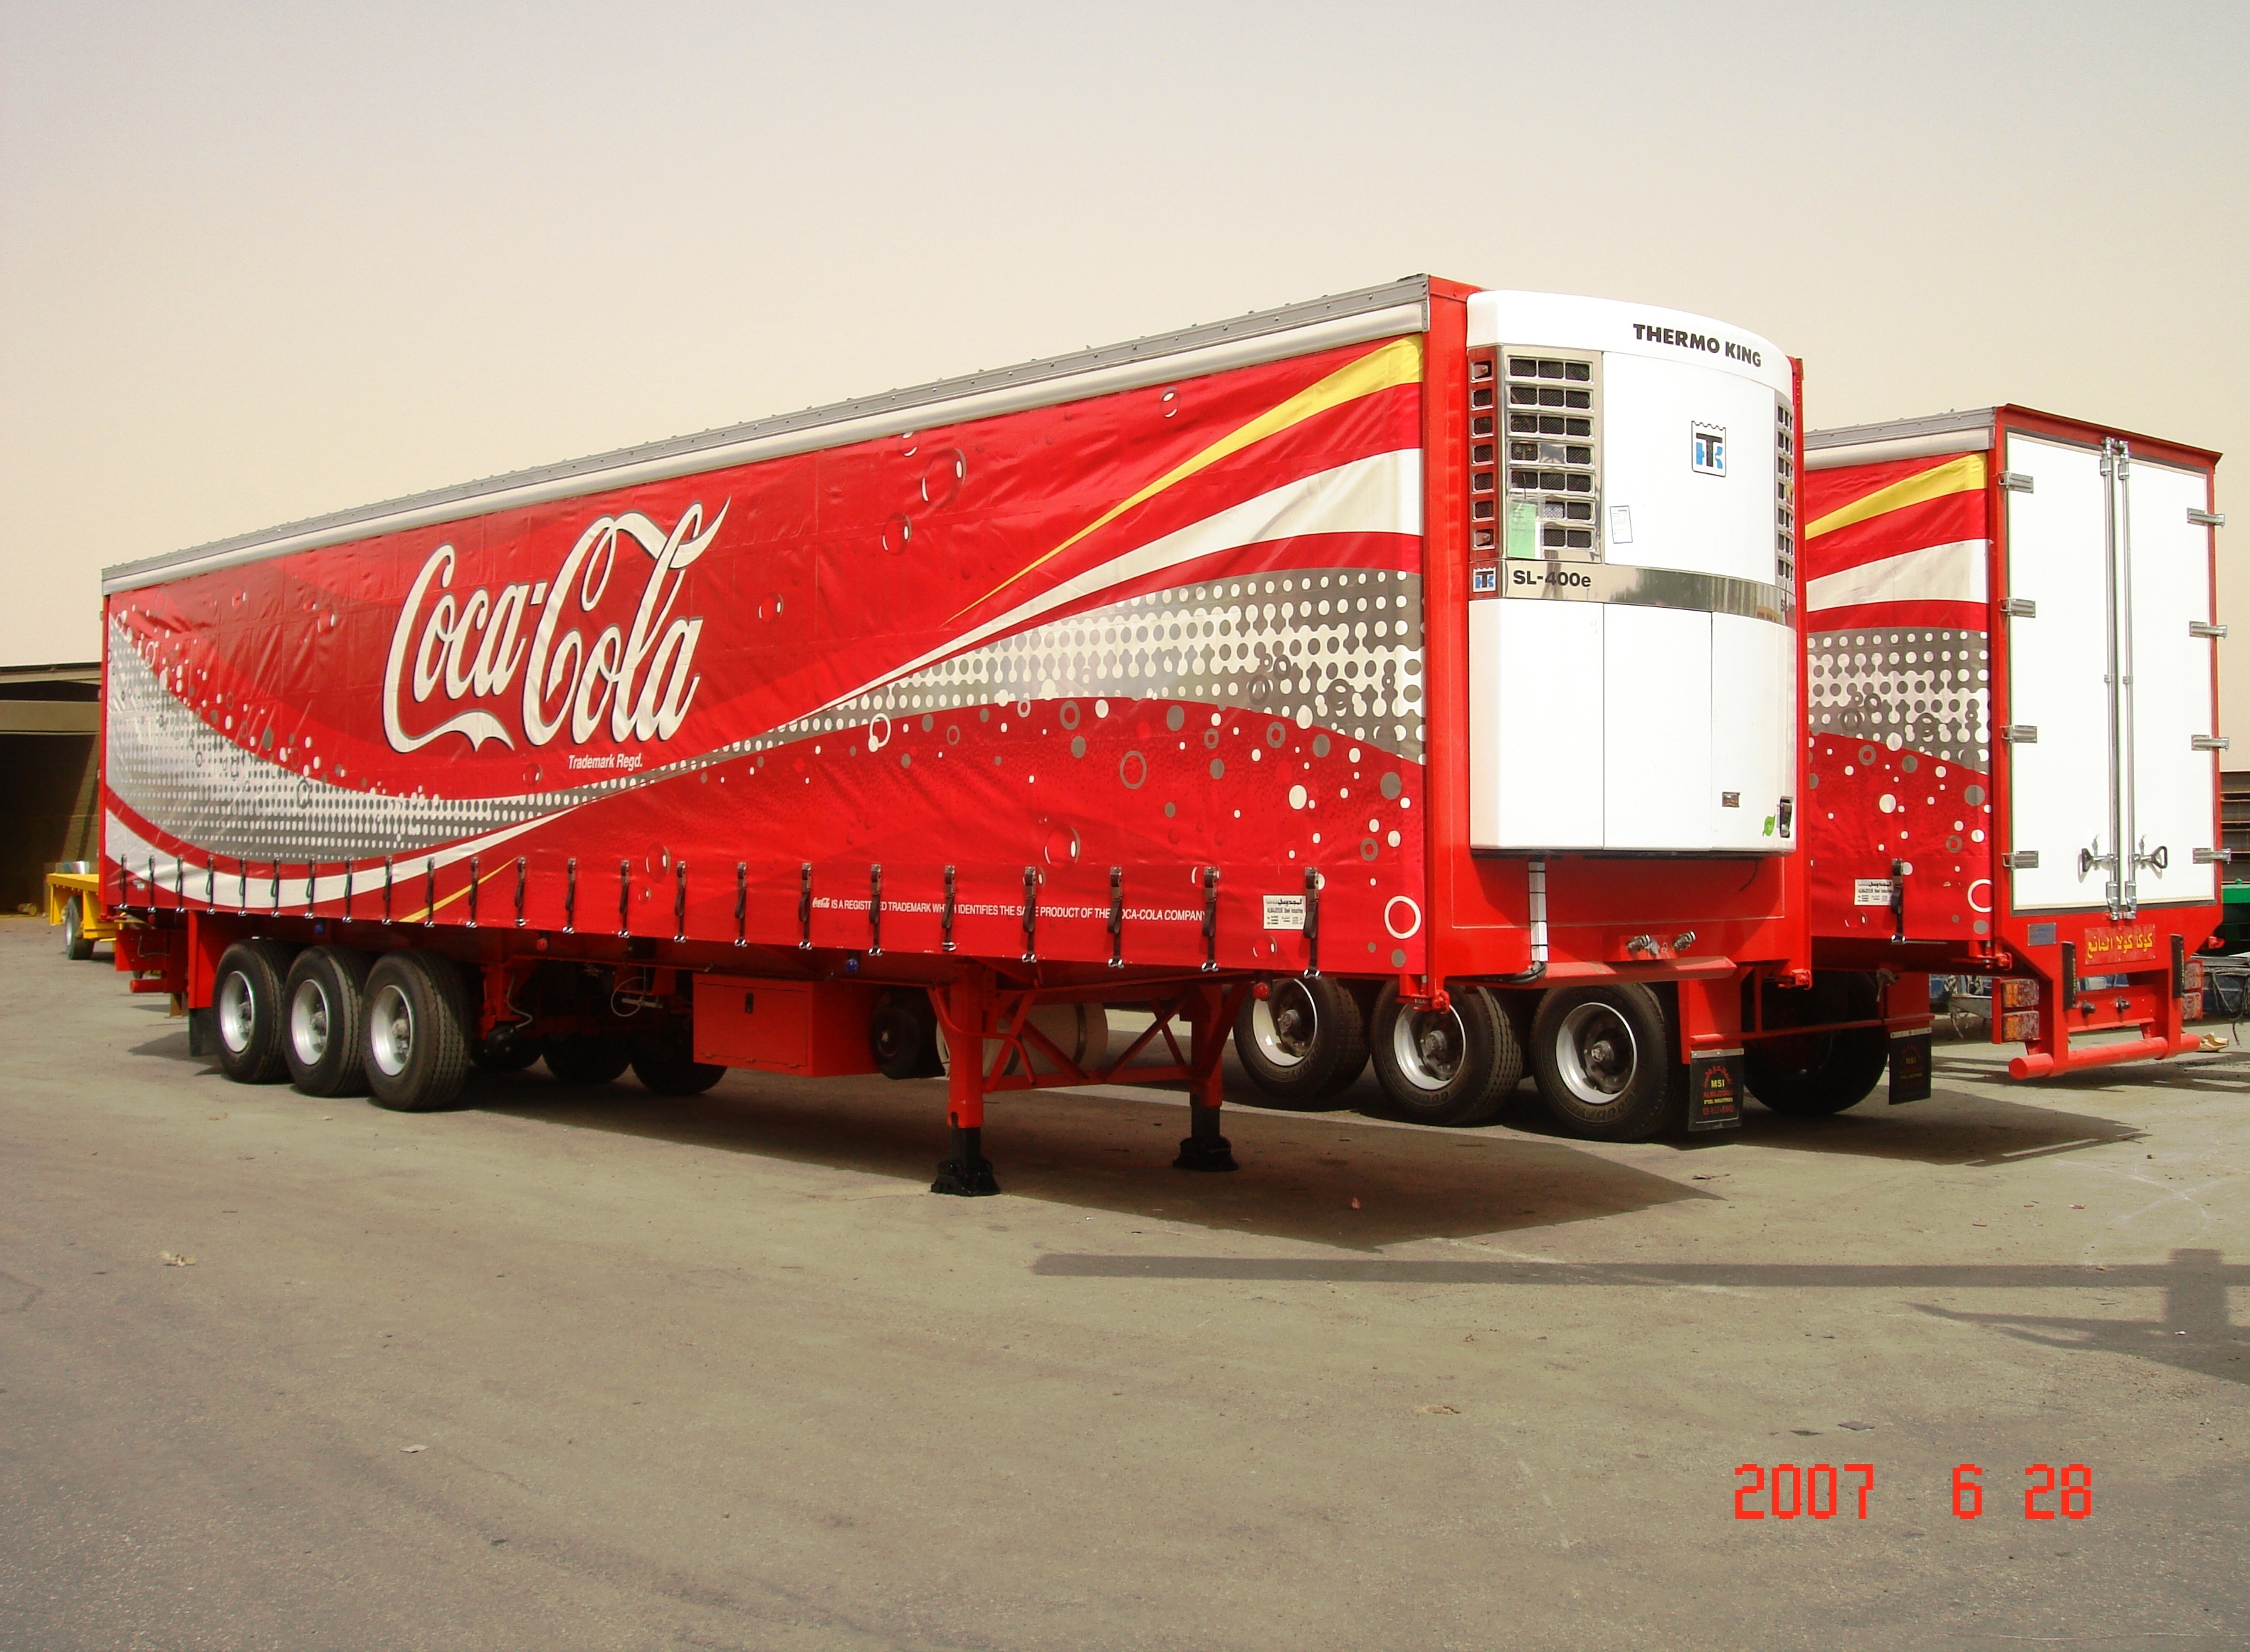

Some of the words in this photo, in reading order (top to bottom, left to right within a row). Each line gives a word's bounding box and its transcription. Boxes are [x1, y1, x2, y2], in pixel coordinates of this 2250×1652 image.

[1633, 323, 1720, 354] THERMO
[1725, 340, 1762, 368] KING
[1513, 569, 1592, 587] SL-400e
[383, 494, 732, 754] Coca-Cola
[569, 754, 616, 769] Trademark
[616, 752, 643, 772] Regd.
[831, 899, 838, 910] IS
[839, 899, 844, 910] A
[888, 901, 931, 913] TRADEMARK
[957, 904, 998, 916] IDENTIFIES
[999, 905, 1015, 916] THE
[1040, 906, 1080, 918] PRODUCT
[1081, 907, 1093, 919] OF
[1094, 908, 1111, 919] THE
[1121, 908, 1162, 920] OCA-COLA
[2115, 934, 2133, 954] كولا
[2136, 932, 2153, 952] كوكا
[1710, 1078, 1725, 1088] MSI
